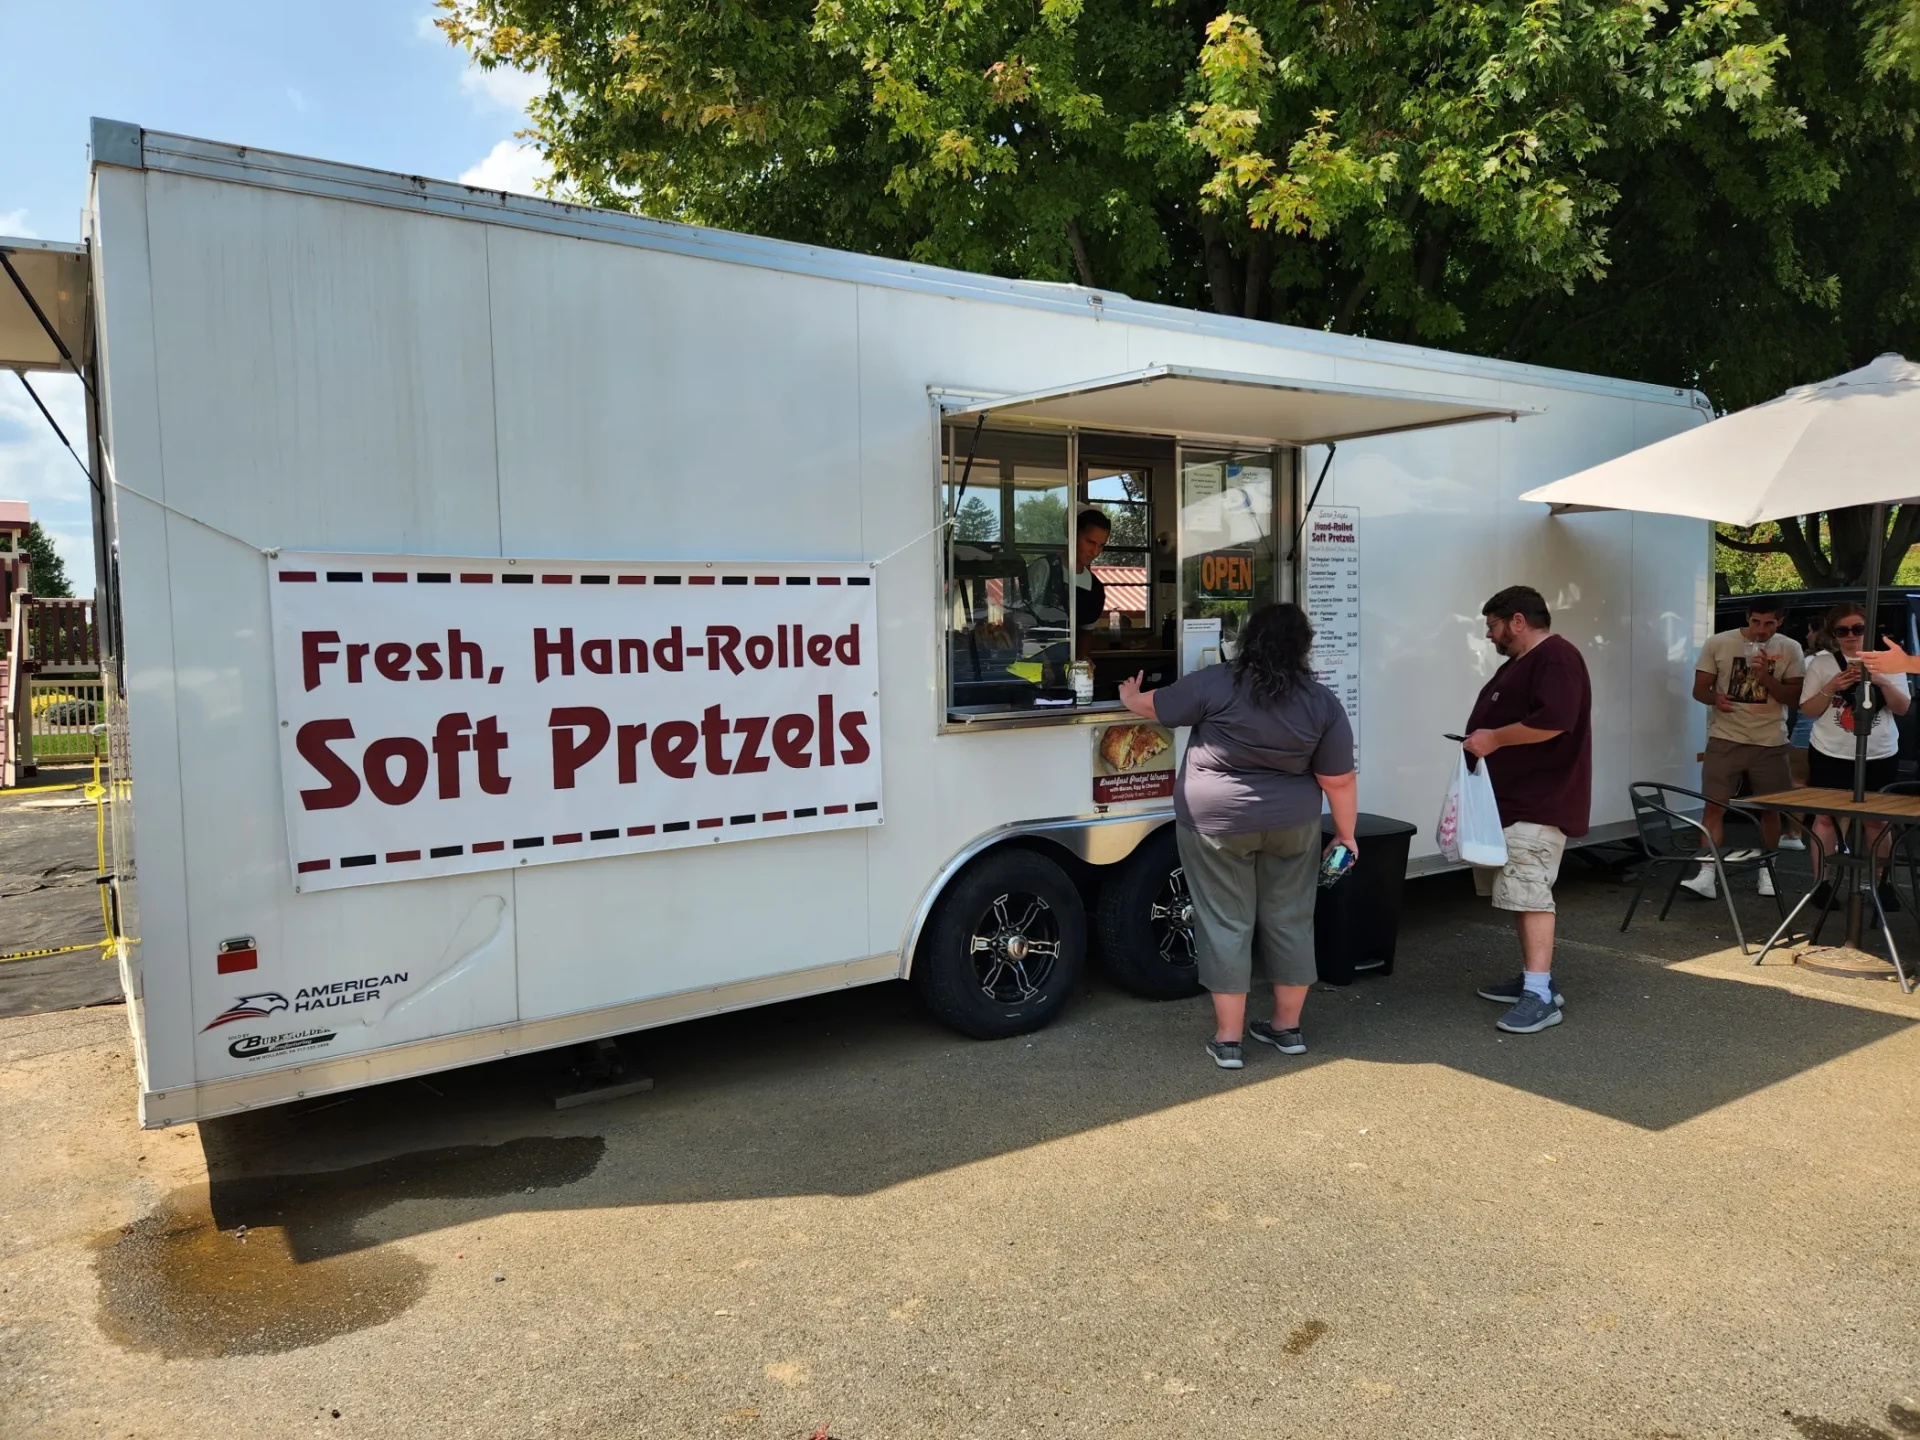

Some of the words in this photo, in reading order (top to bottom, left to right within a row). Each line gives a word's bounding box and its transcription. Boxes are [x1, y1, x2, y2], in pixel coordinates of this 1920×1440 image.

[1311, 532, 1326, 542] Soft
[1328, 533, 1355, 543] Pretzels
[1314, 521, 1353, 532] Hand-Rolled
[1201, 555, 1252, 591] OPEN
[302, 628, 505, 693] Fresh,
[533, 622, 861, 684] Hand-Rolled
[296, 711, 512, 812] Soft
[548, 694, 871, 790] Pretzels
[1100, 776, 1129, 787] Breakfast
[1129, 774, 1149, 785] Pretzel
[1150, 773, 1169, 782] Wraps
[295, 972, 409, 1000] AMERICAN
[295, 989, 381, 1013] HAULER
